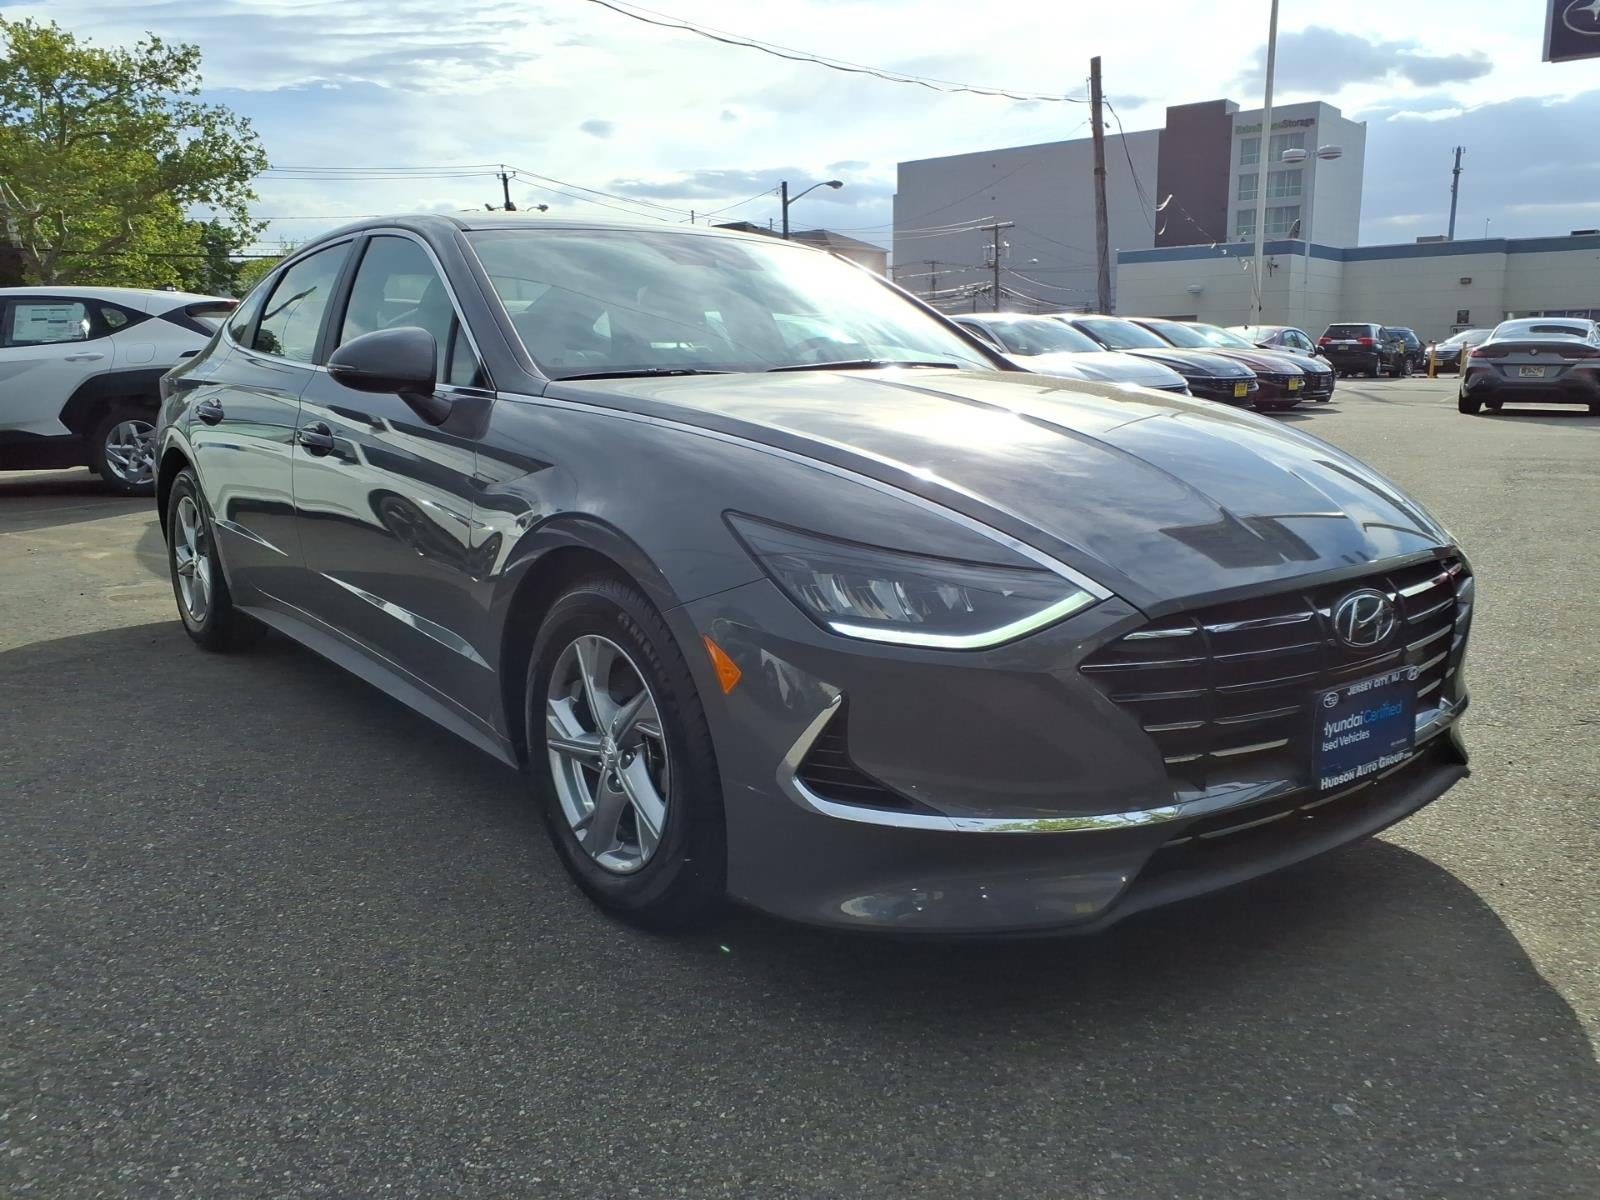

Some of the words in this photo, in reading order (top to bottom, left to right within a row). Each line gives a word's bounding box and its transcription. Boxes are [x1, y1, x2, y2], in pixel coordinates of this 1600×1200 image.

[1347, 680, 1373, 695] JERSEY
[1339, 730, 1370, 747] Vehicles
[1320, 769, 1354, 790] HUDSON
[1356, 761, 1377, 777] AUTO
